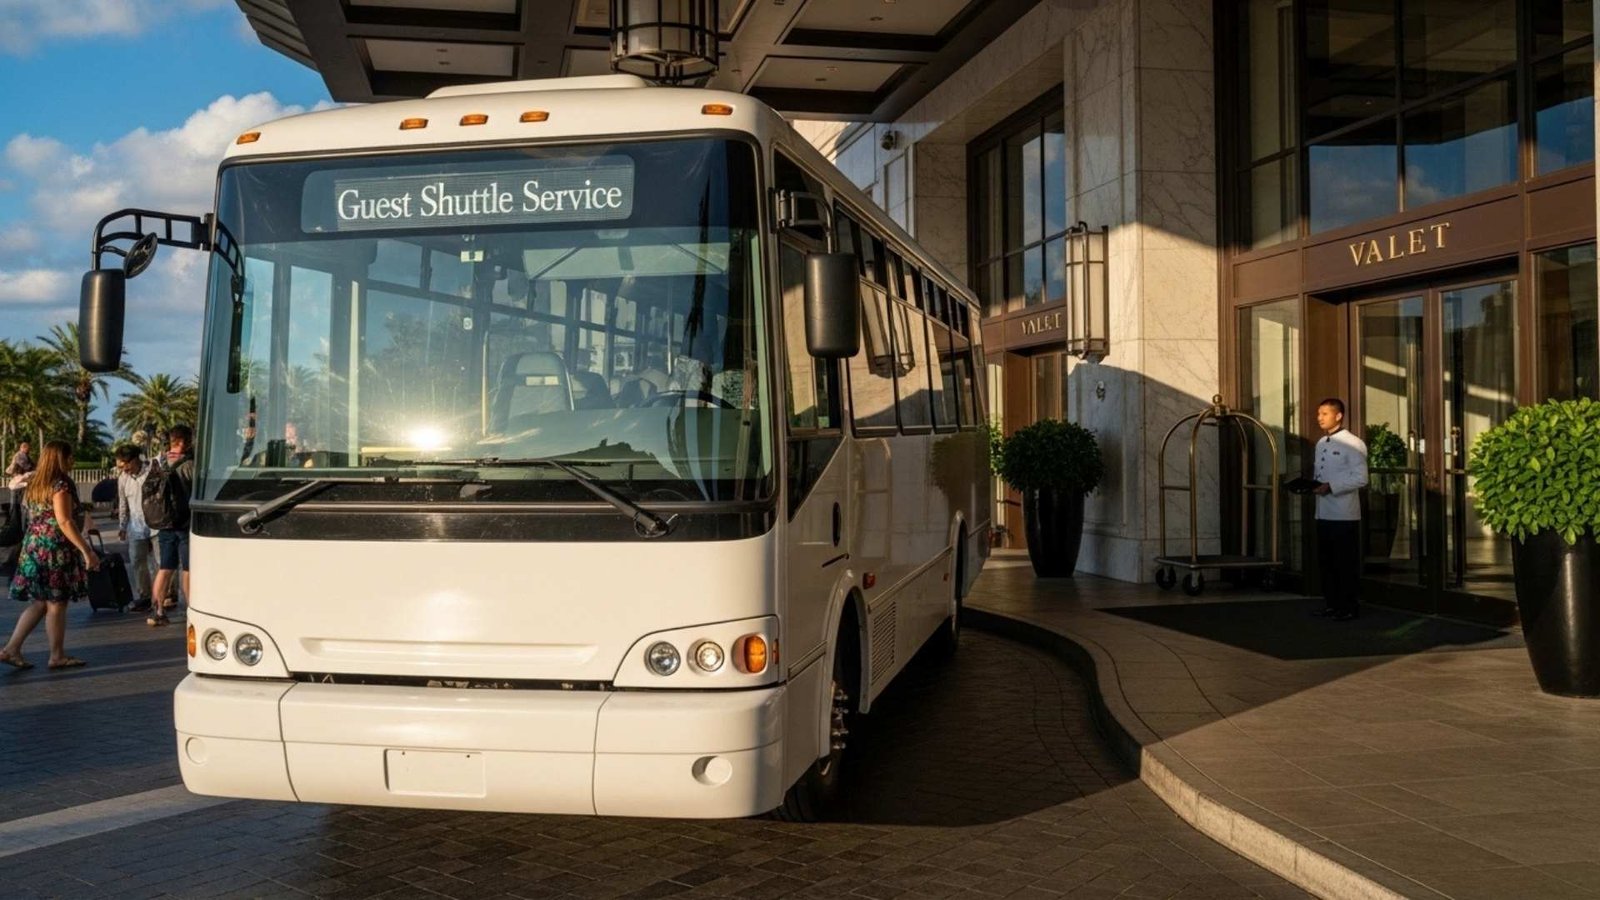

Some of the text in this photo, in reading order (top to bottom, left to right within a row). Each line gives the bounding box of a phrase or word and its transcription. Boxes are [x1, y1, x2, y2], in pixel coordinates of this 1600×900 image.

[337, 180, 622, 221] Guest Shuttle Service
[1349, 222, 1450, 267] VALET
